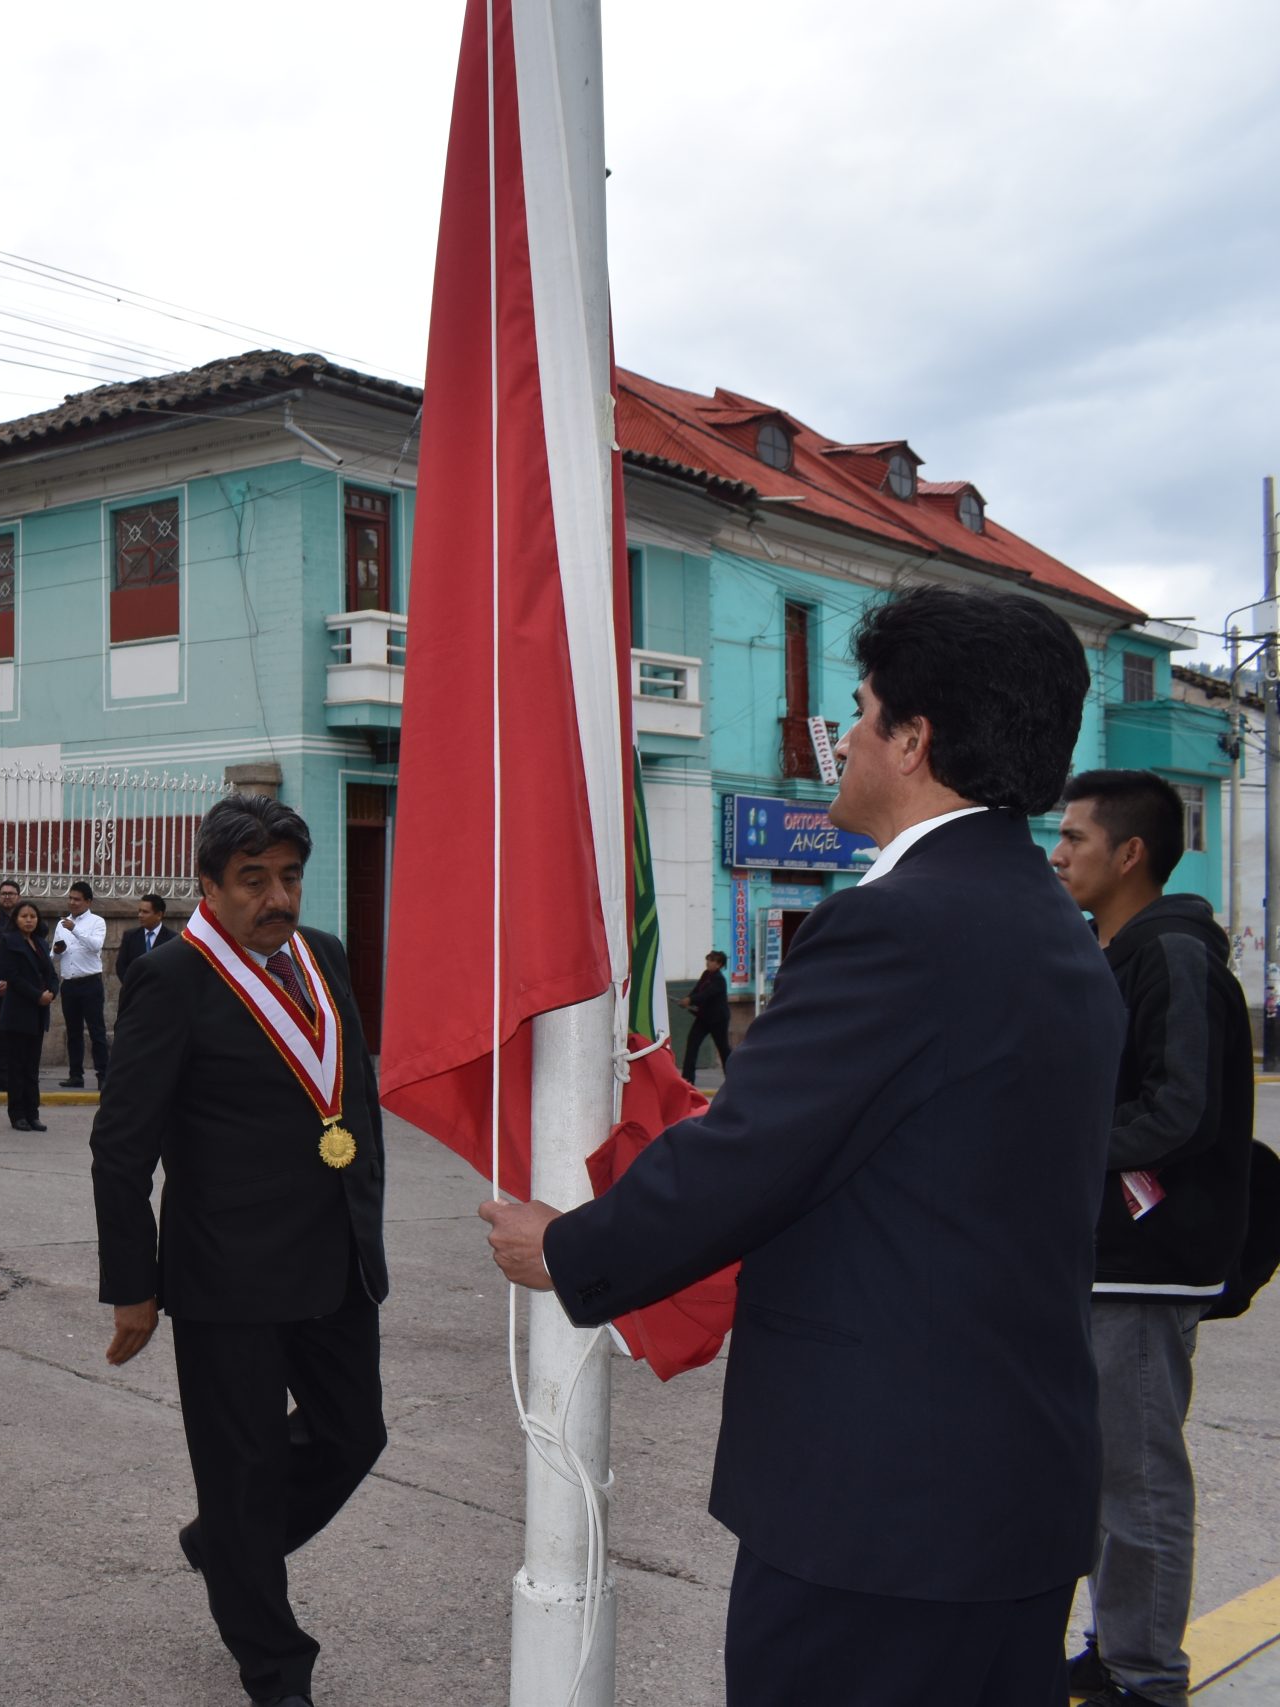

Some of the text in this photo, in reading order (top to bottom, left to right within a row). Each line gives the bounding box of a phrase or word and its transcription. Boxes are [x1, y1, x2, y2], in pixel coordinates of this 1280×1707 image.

[724, 796, 734, 865] ORTOPEDIA
[784, 813, 839, 831] ORTOPE
[789, 831, 841, 854] ANGEL
[736, 881, 746, 972] LABORATORIO
